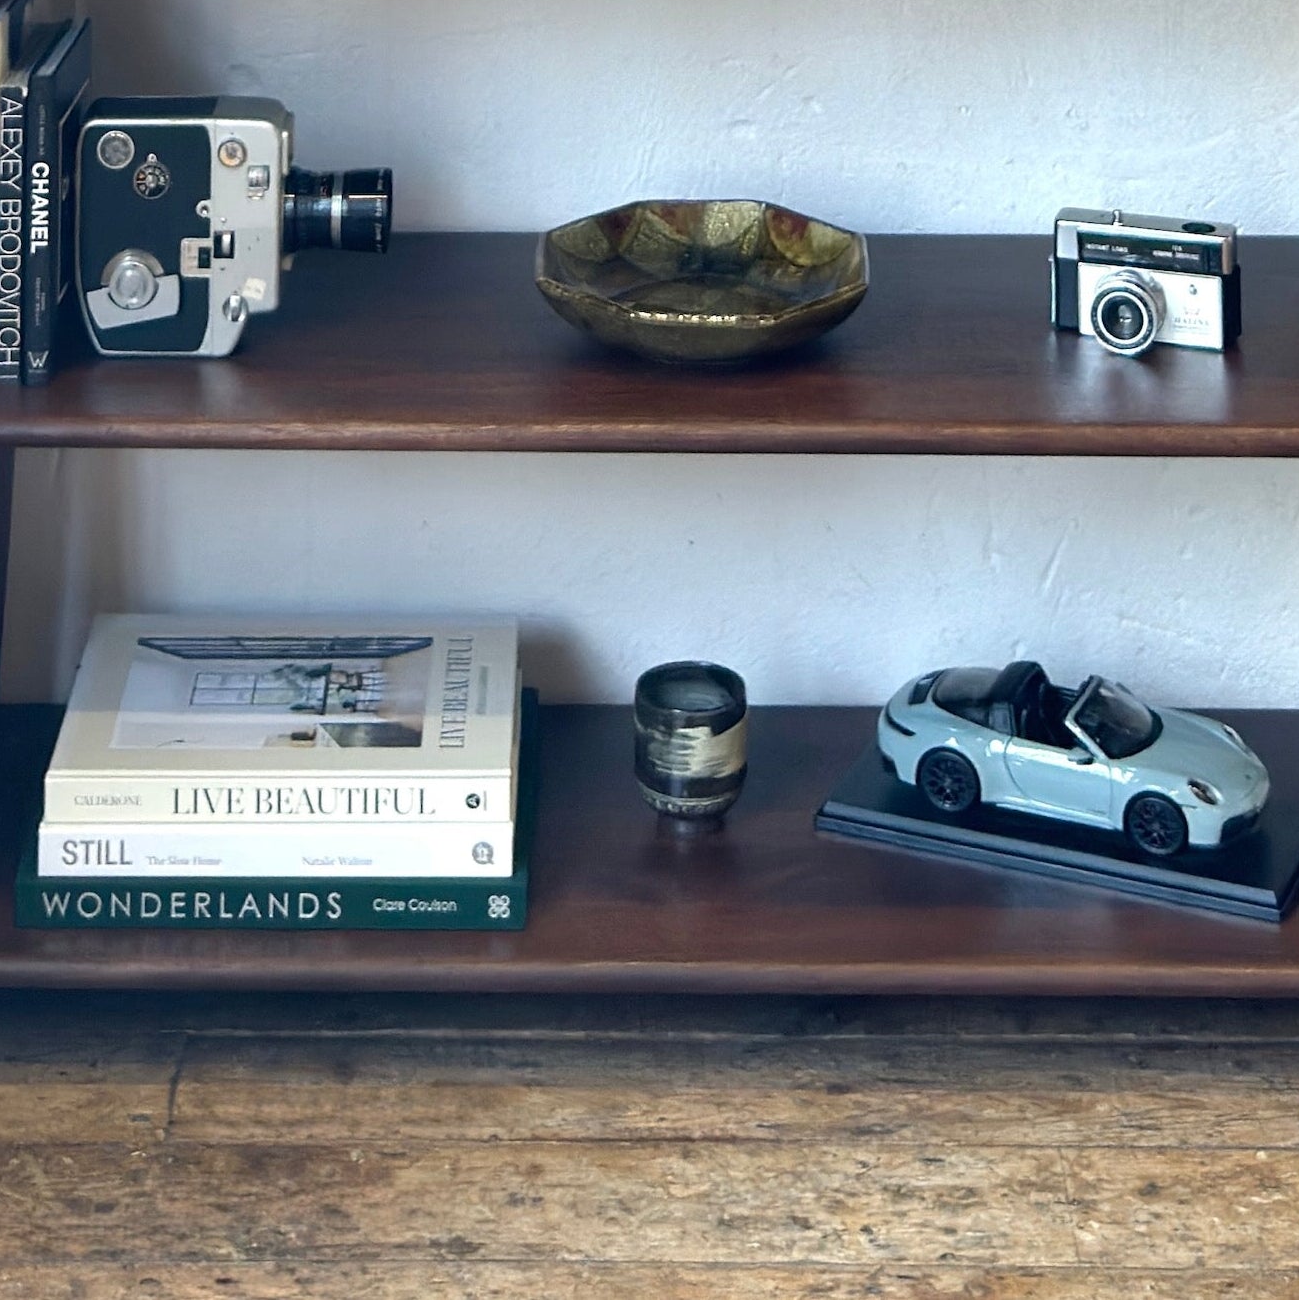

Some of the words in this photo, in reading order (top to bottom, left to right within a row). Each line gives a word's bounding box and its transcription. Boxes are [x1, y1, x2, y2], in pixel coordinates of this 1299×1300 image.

[0, 97, 23, 190] ALEXEY
[30, 161, 50, 255] CHANEL
[438, 715, 467, 749] LIVE
[172, 788, 244, 815] LIVE
[255, 788, 436, 815] BEAUTIFUL
[61, 839, 132, 865] STILL
[146, 856, 166, 865] The
[42, 891, 344, 919] WONDERLANDS
[373, 898, 407, 912] Clare
[409, 898, 457, 913] Coulson
